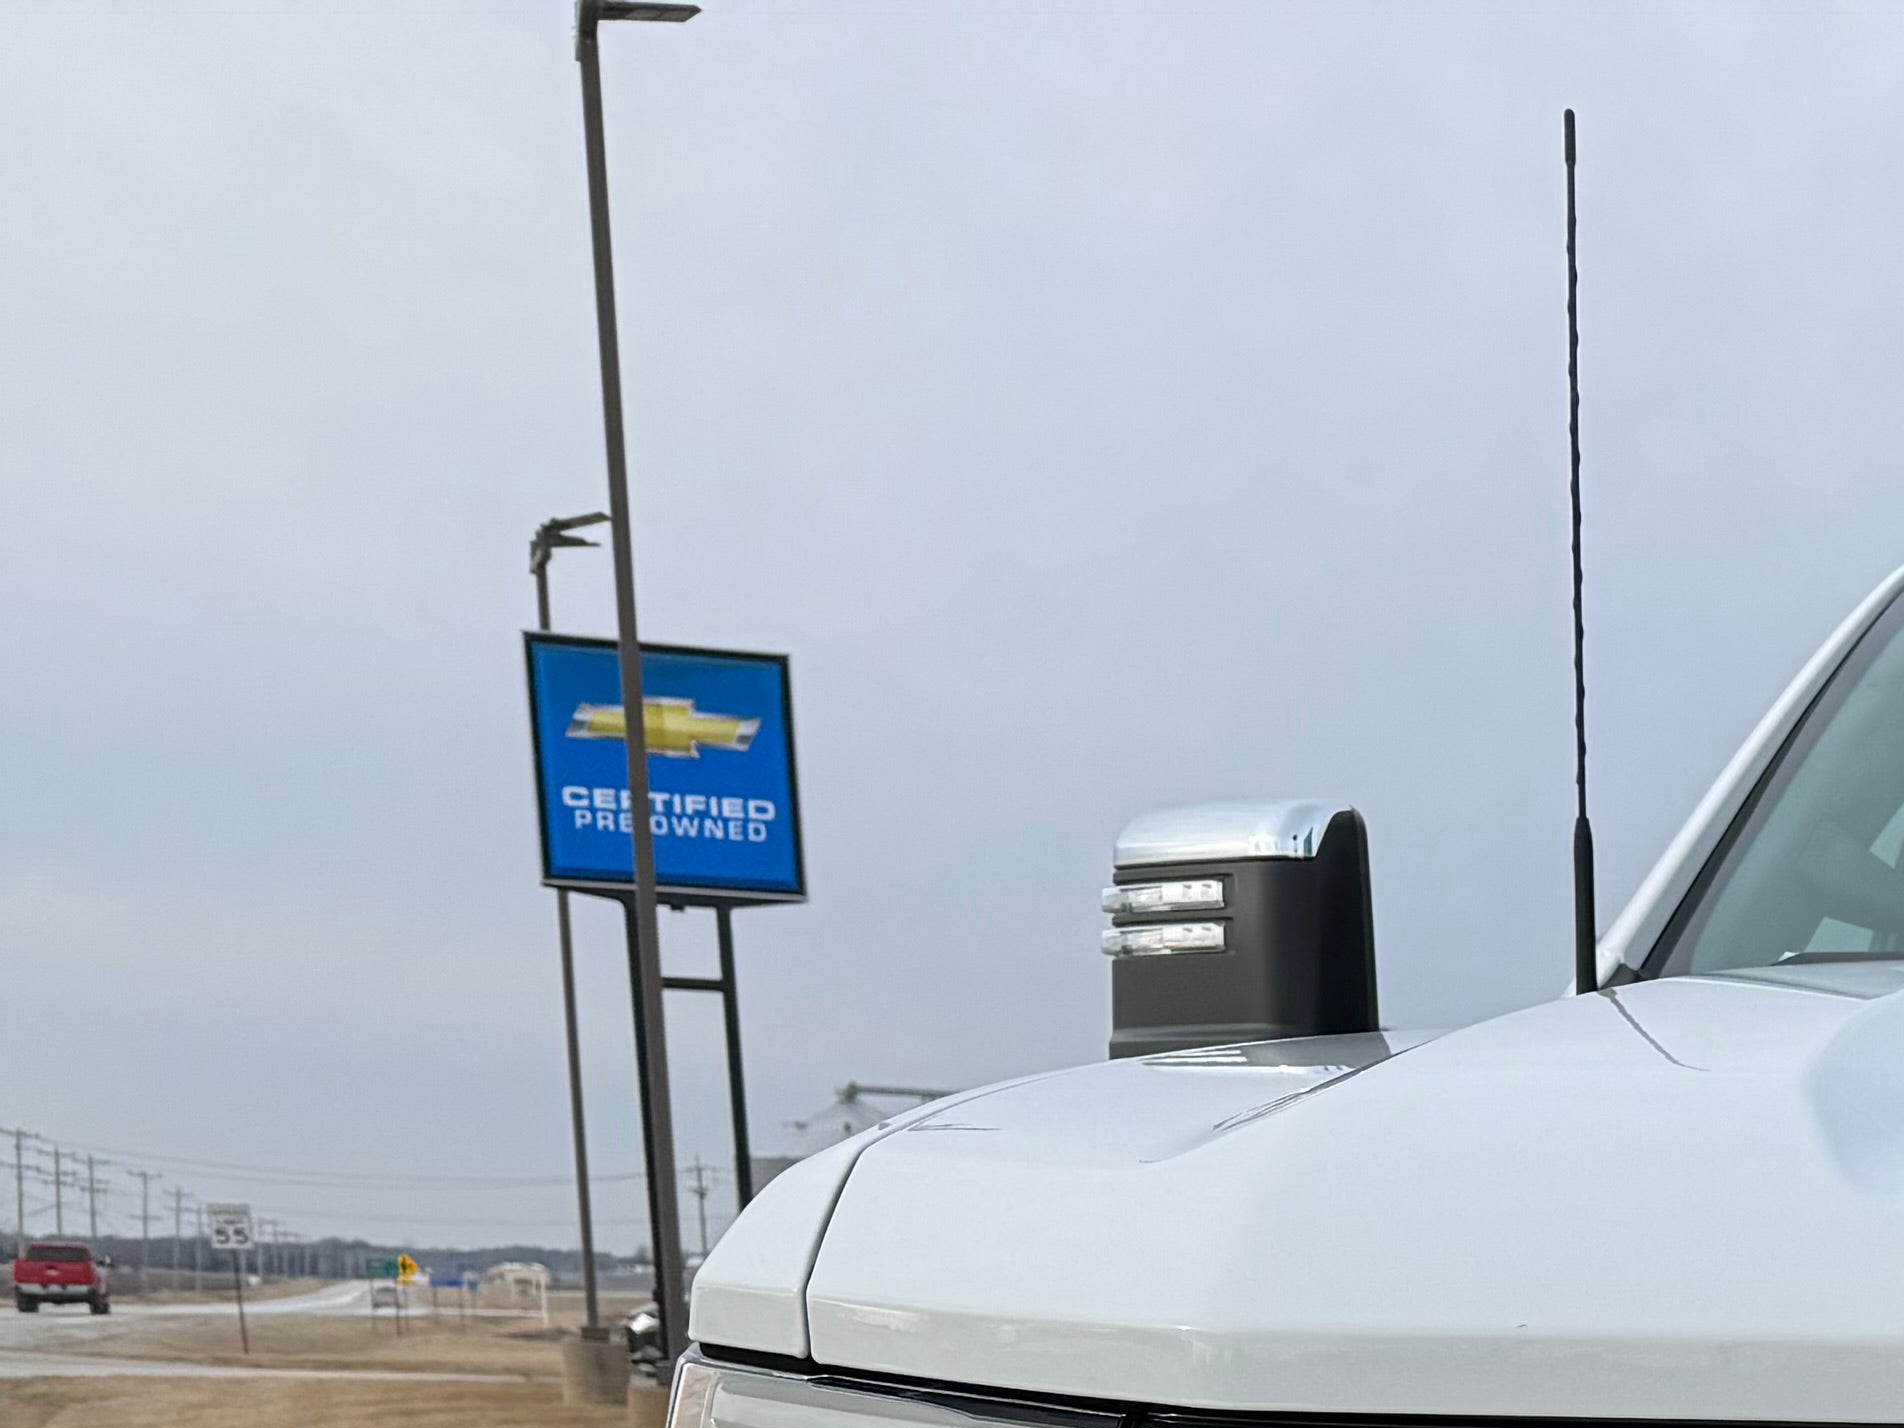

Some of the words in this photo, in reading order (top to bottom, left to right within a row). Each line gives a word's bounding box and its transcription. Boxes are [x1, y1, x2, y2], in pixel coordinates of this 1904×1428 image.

[574, 810, 633, 834] PRE
[649, 815, 767, 842] OWNED
[215, 1227, 249, 1245] 55
